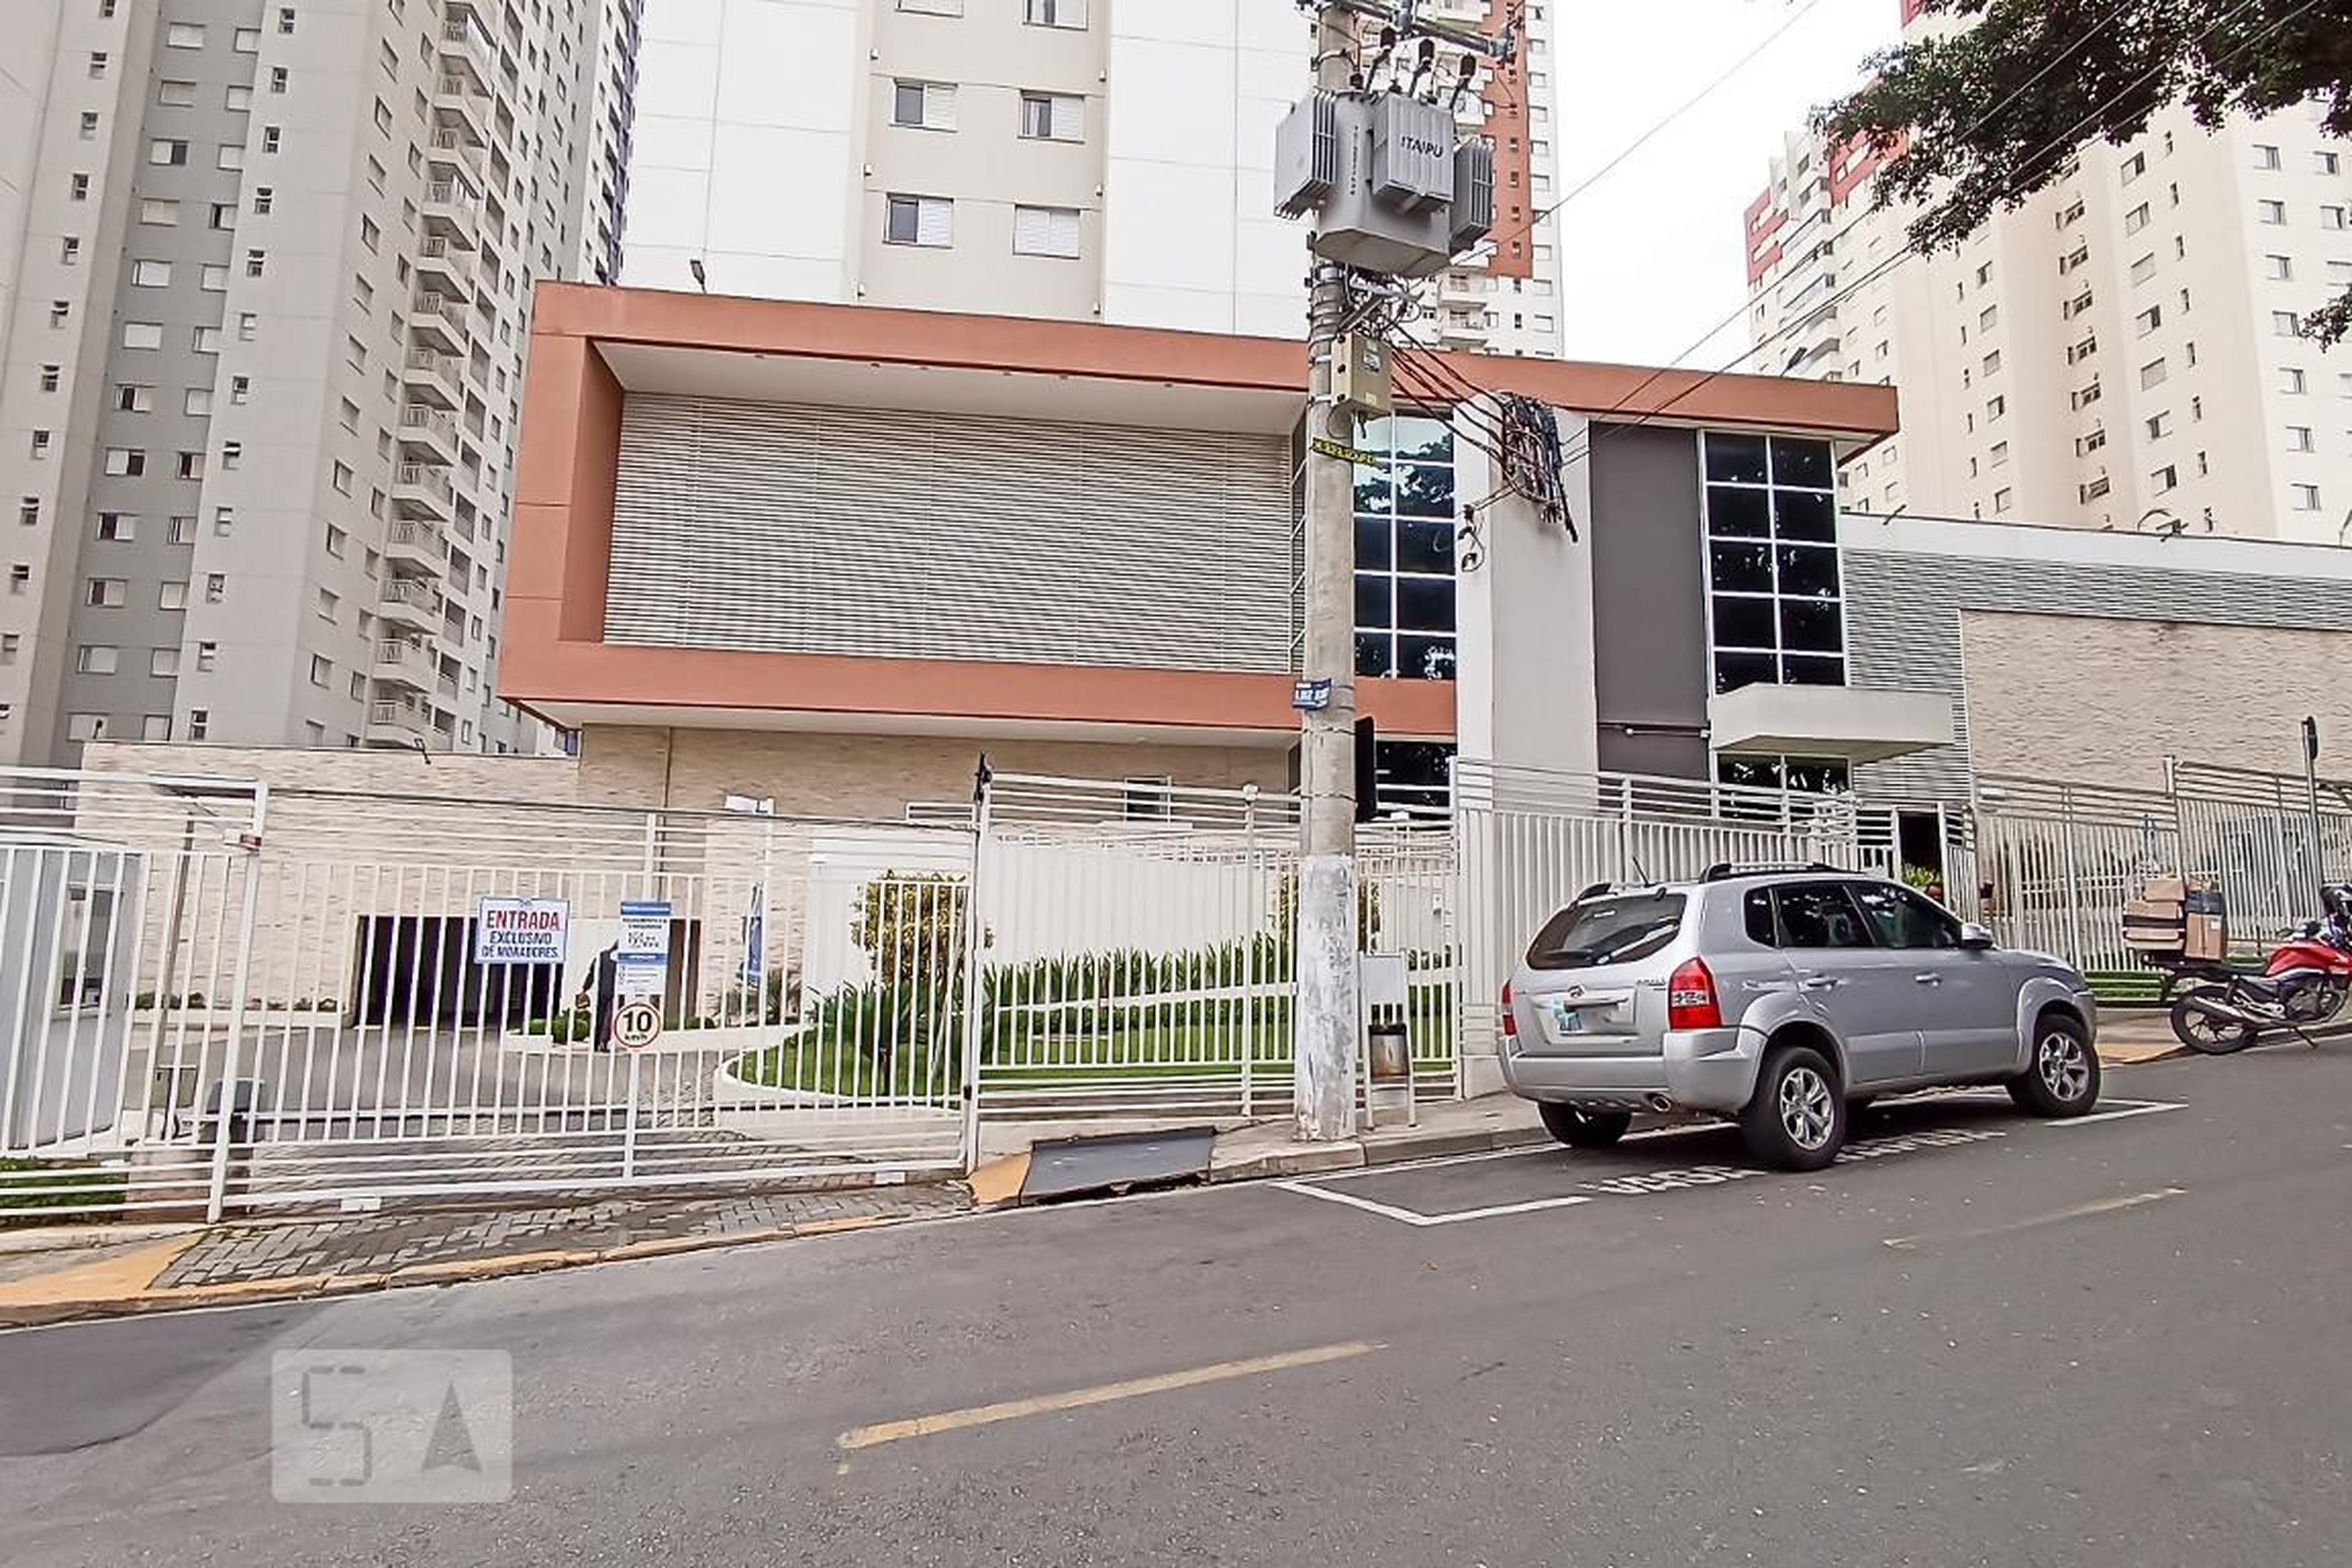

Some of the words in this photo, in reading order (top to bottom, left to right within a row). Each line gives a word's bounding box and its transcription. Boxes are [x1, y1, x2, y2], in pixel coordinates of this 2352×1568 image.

[1401, 136, 1443, 158] ITAIPU
[486, 910, 560, 930] ENTRADA
[489, 930, 552, 945] EXCLUSIVO
[481, 945, 496, 958] DE
[497, 946, 559, 959] MORADORES
[623, 1011, 652, 1032] 10
